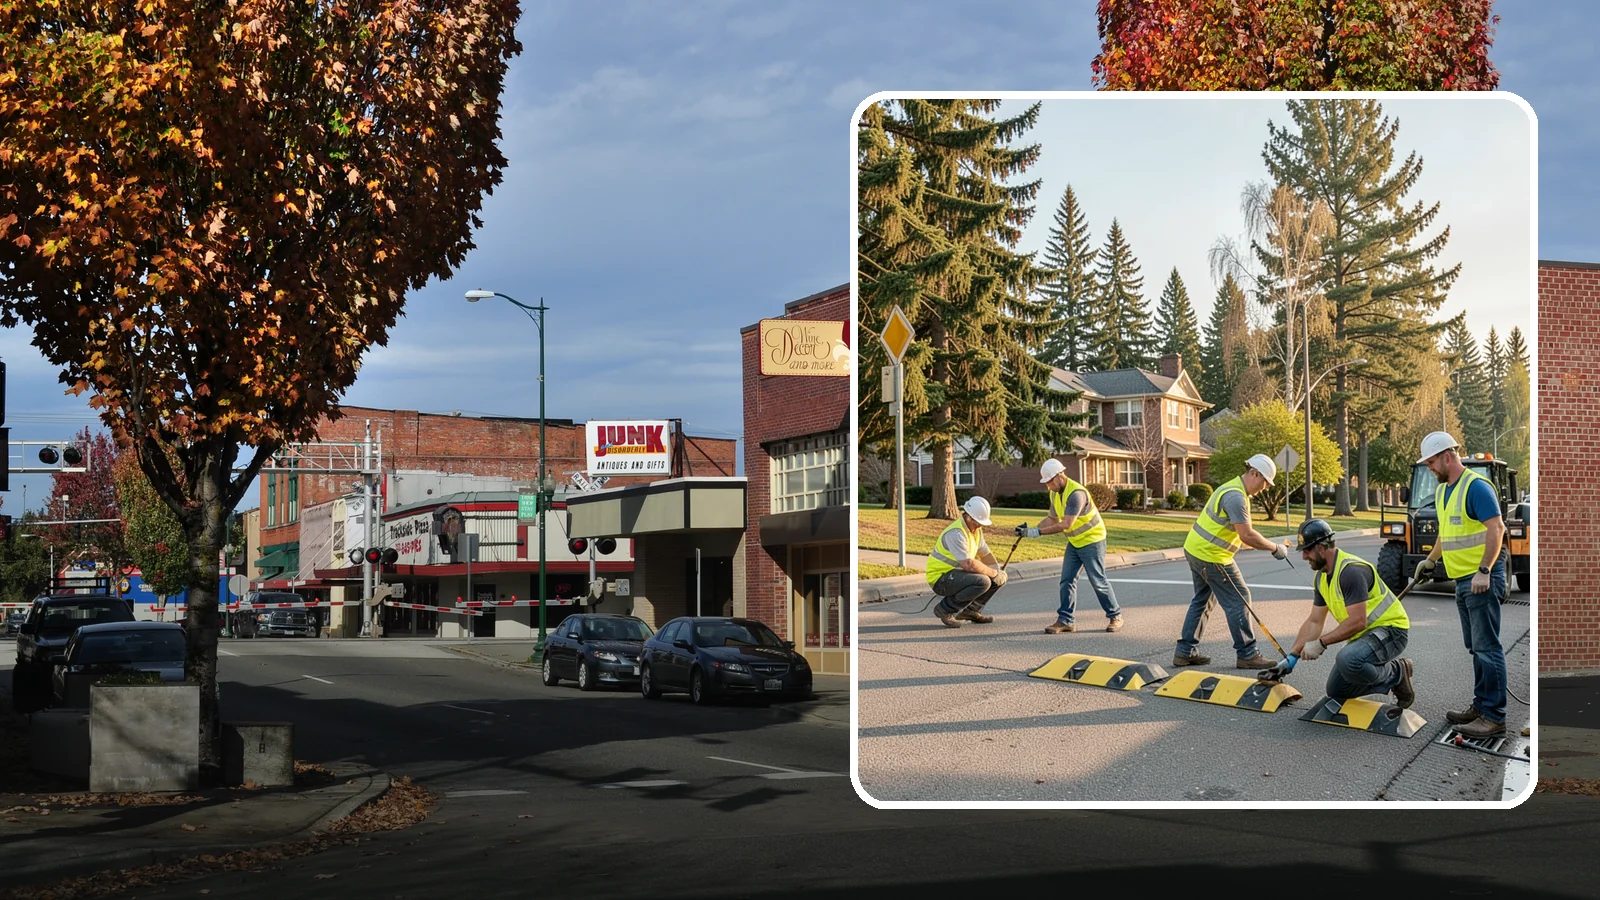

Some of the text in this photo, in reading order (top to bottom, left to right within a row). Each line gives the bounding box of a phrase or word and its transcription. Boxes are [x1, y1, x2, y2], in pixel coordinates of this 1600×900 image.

[595, 425, 665, 457] JUNK
[607, 446, 646, 454] DISORDERLY
[596, 460, 665, 470] ANTIQUES AND GIFTS
[390, 519, 429, 539] Trackside Pizza
